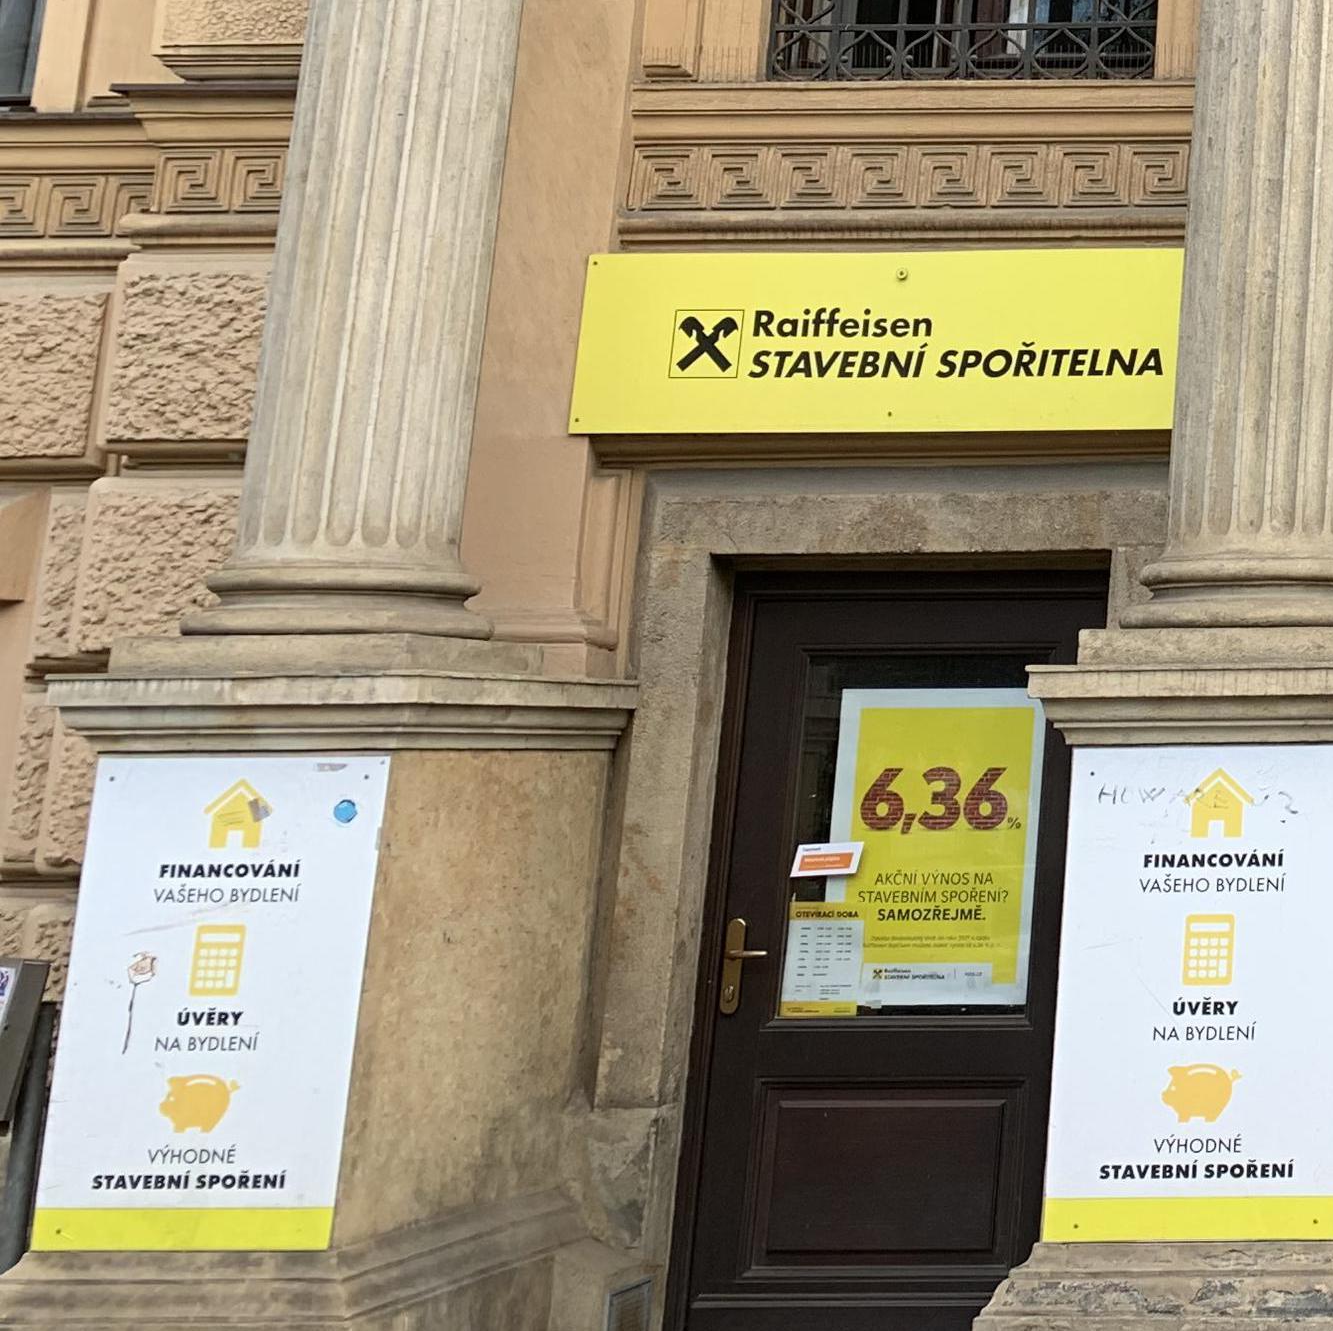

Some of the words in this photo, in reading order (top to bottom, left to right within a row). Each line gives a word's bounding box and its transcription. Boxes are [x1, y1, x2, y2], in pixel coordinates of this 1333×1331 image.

[752, 308, 933, 338] Raiffeisen
[748, 342, 929, 379] STAVEBNÍ
[936, 341, 1164, 379] SPOŘITELNA
[159, 859, 301, 879] FINANCOVÁNÍ
[1143, 848, 1284, 869] FINANCOVÁNÍ
[875, 869, 918, 886] AKČNÍ
[921, 869, 970, 886] VÝNOS
[973, 872, 994, 886] NA
[1139, 873, 1210, 893] VAŠEHO
[1216, 872, 1286, 893] BYDLENÍ
[153, 883, 225, 904] VAŠEHO
[229, 883, 301, 903] BYDLENÍ
[858, 887, 937, 904] STAVEBNÍM
[877, 905, 987, 922] SAMOZŘEJMĚ.
[1172, 996, 1239, 1016] ÚVĚRY
[177, 1007, 244, 1027] ÚVĚRY
[1152, 1026, 1180, 1041] NA
[1185, 1020, 1257, 1041] BYDLENÍ
[154, 1036, 182, 1052] NA
[187, 1031, 260, 1052] BYDLENÍ
[1153, 1133, 1242, 1154] VÝHODNÉ
[148, 1144, 237, 1165] VÝHODNÉ
[1099, 1159, 1198, 1180] STAVEBNÍ
[1203, 1158, 1294, 1179] SPOŘENÍ
[91, 1170, 191, 1190] STAVEBNÍ
[195, 1170, 286, 1190] SPOŘENÍ
